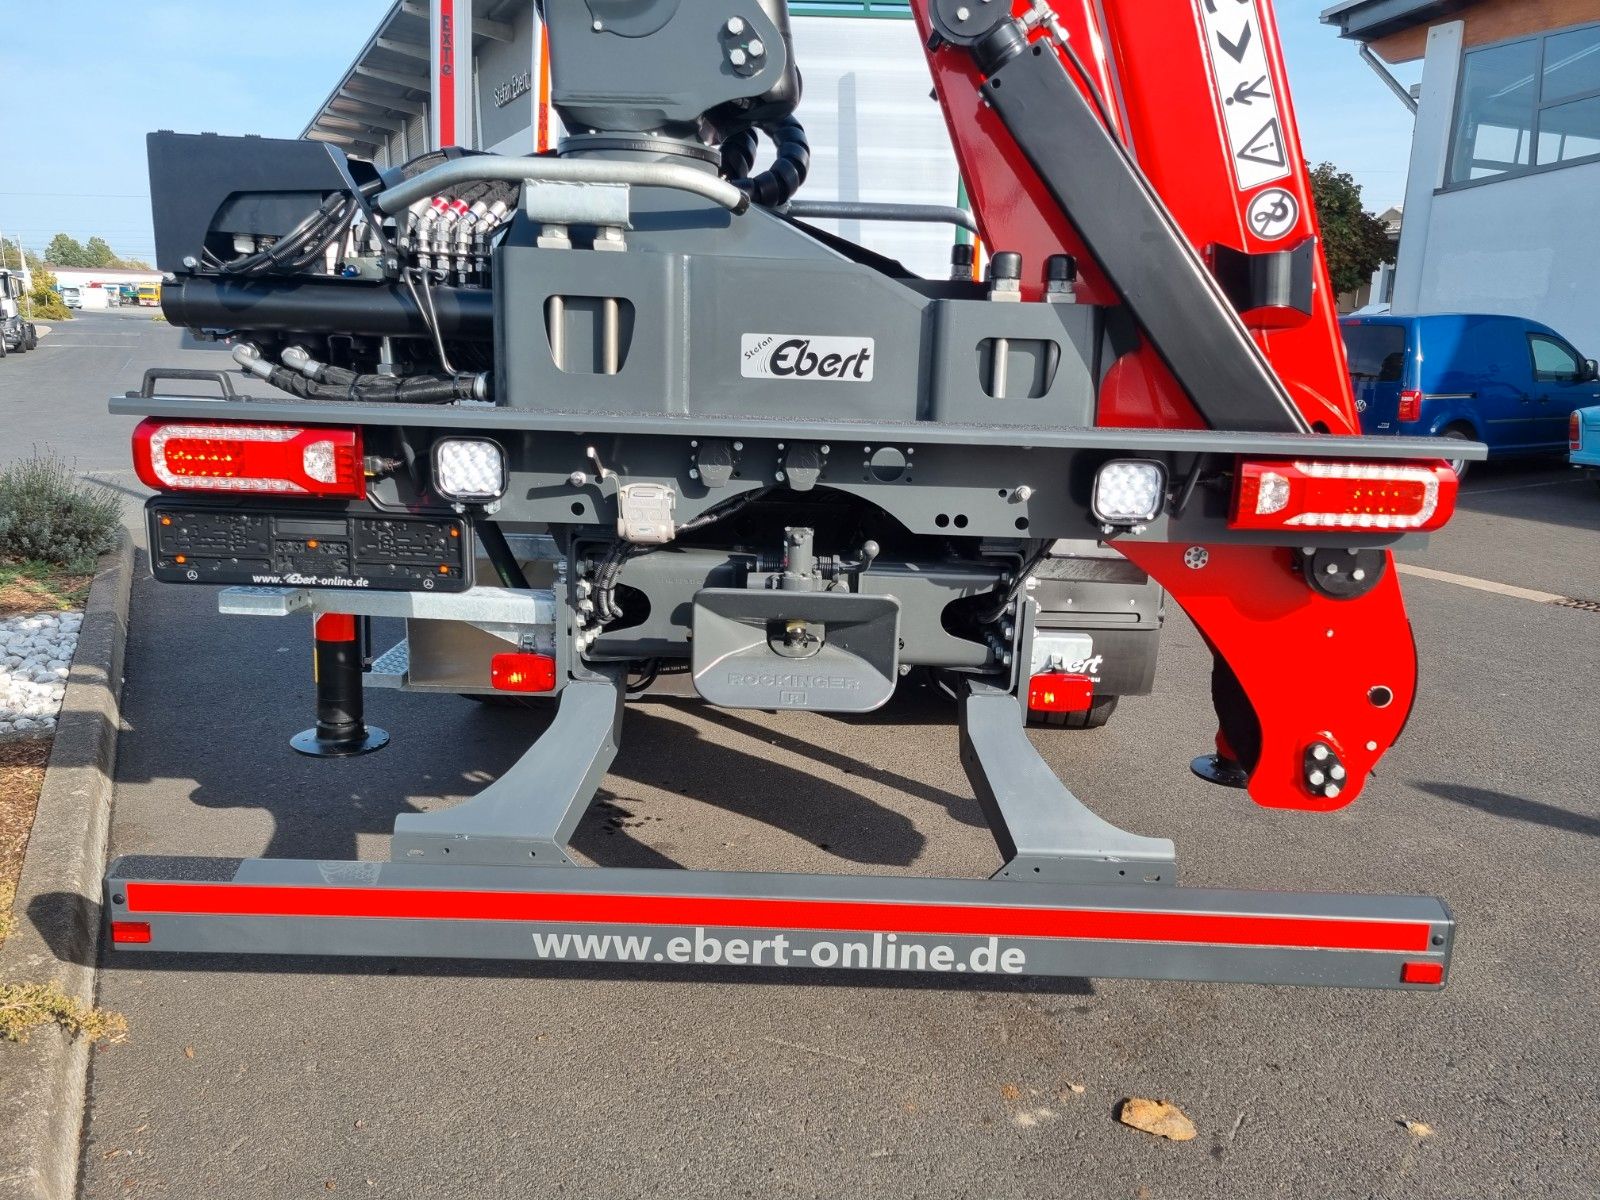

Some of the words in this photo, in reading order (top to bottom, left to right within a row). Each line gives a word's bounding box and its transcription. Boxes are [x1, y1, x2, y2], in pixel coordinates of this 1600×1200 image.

[744, 336, 774, 360] Stefan
[769, 338, 870, 379] Ebert
[252, 573, 369, 587] www.Ebert-online.de
[727, 671, 862, 690] ROCKINGER
[531, 926, 1026, 975] www.ebert-online.de
